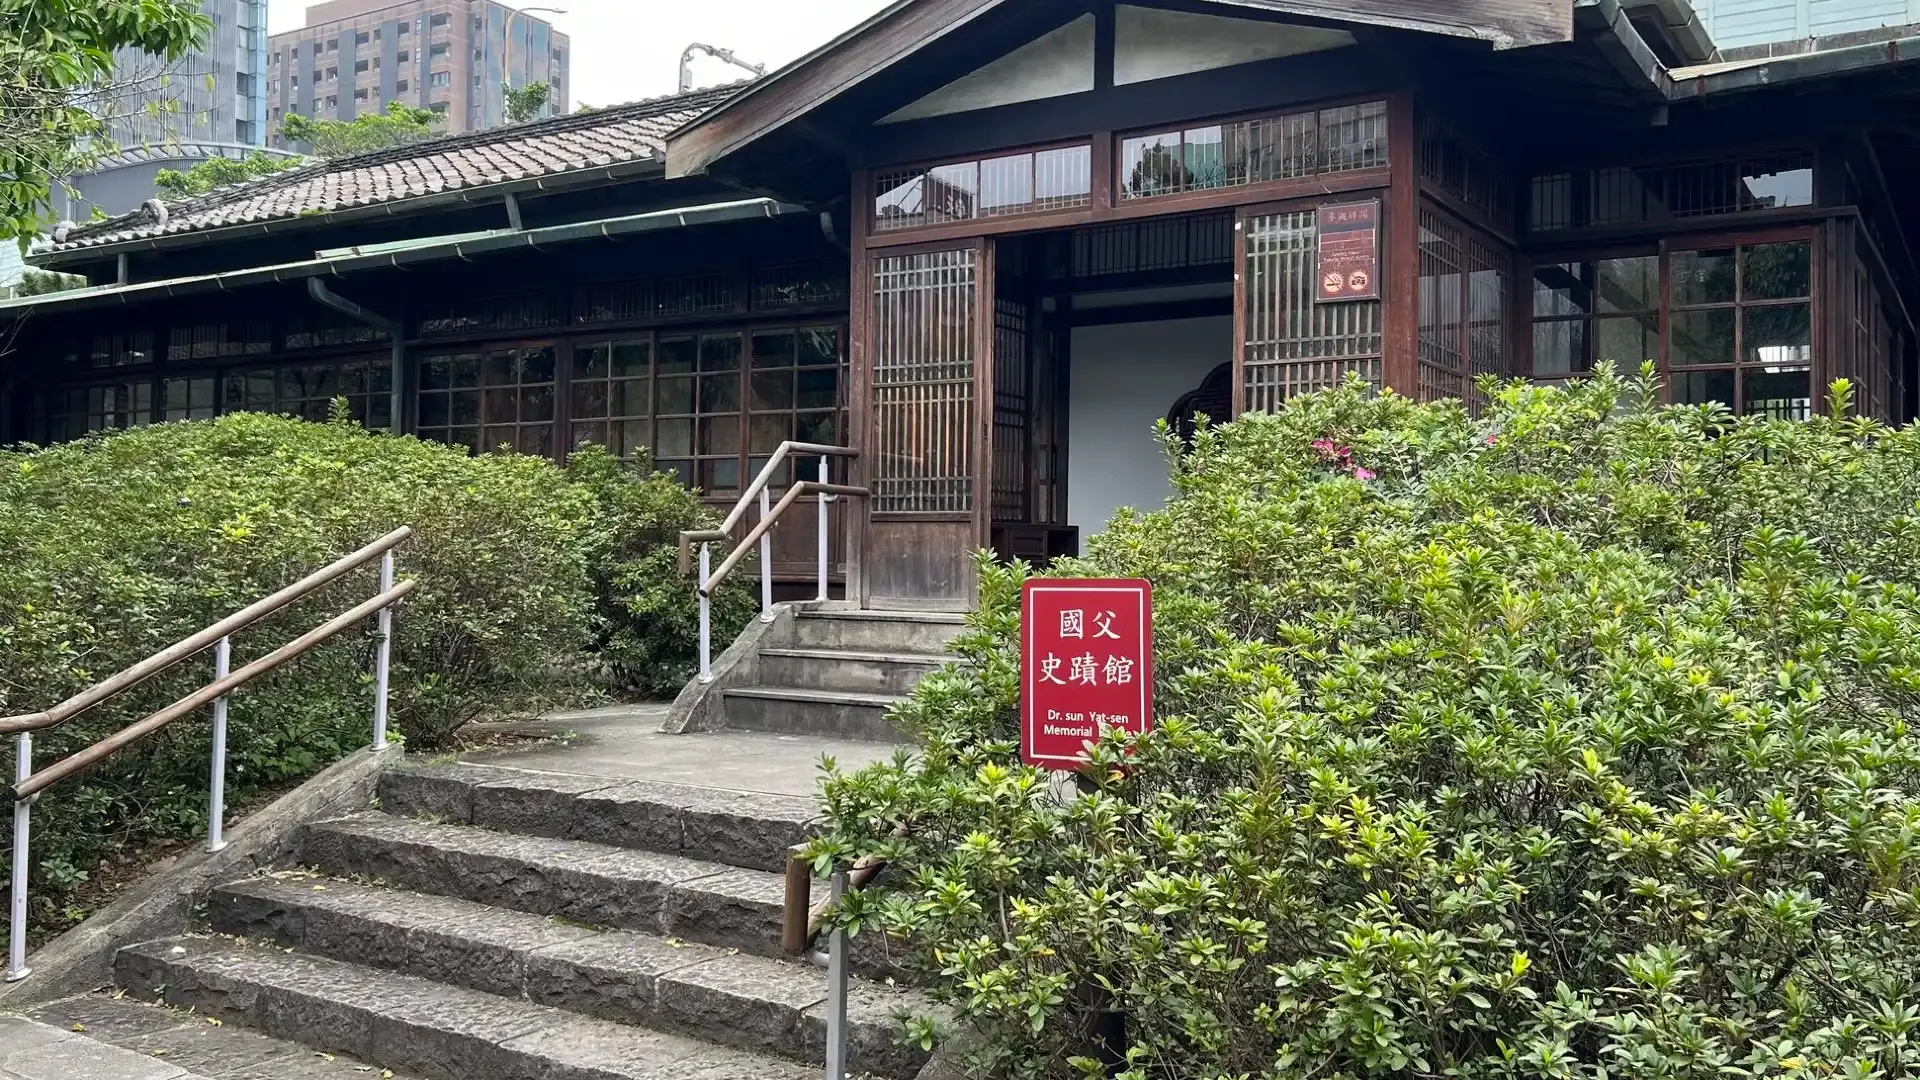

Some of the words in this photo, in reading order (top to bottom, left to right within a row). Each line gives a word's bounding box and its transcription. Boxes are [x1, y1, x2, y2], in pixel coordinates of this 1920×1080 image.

[1060, 608, 1121, 639] 國父
[1038, 652, 1134, 686] 史蹟館
[1048, 710, 1063, 720] Dr.
[1065, 712, 1084, 722] sun
[1089, 711, 1129, 723] Yat-sen
[1044, 725, 1093, 737] Memorial
